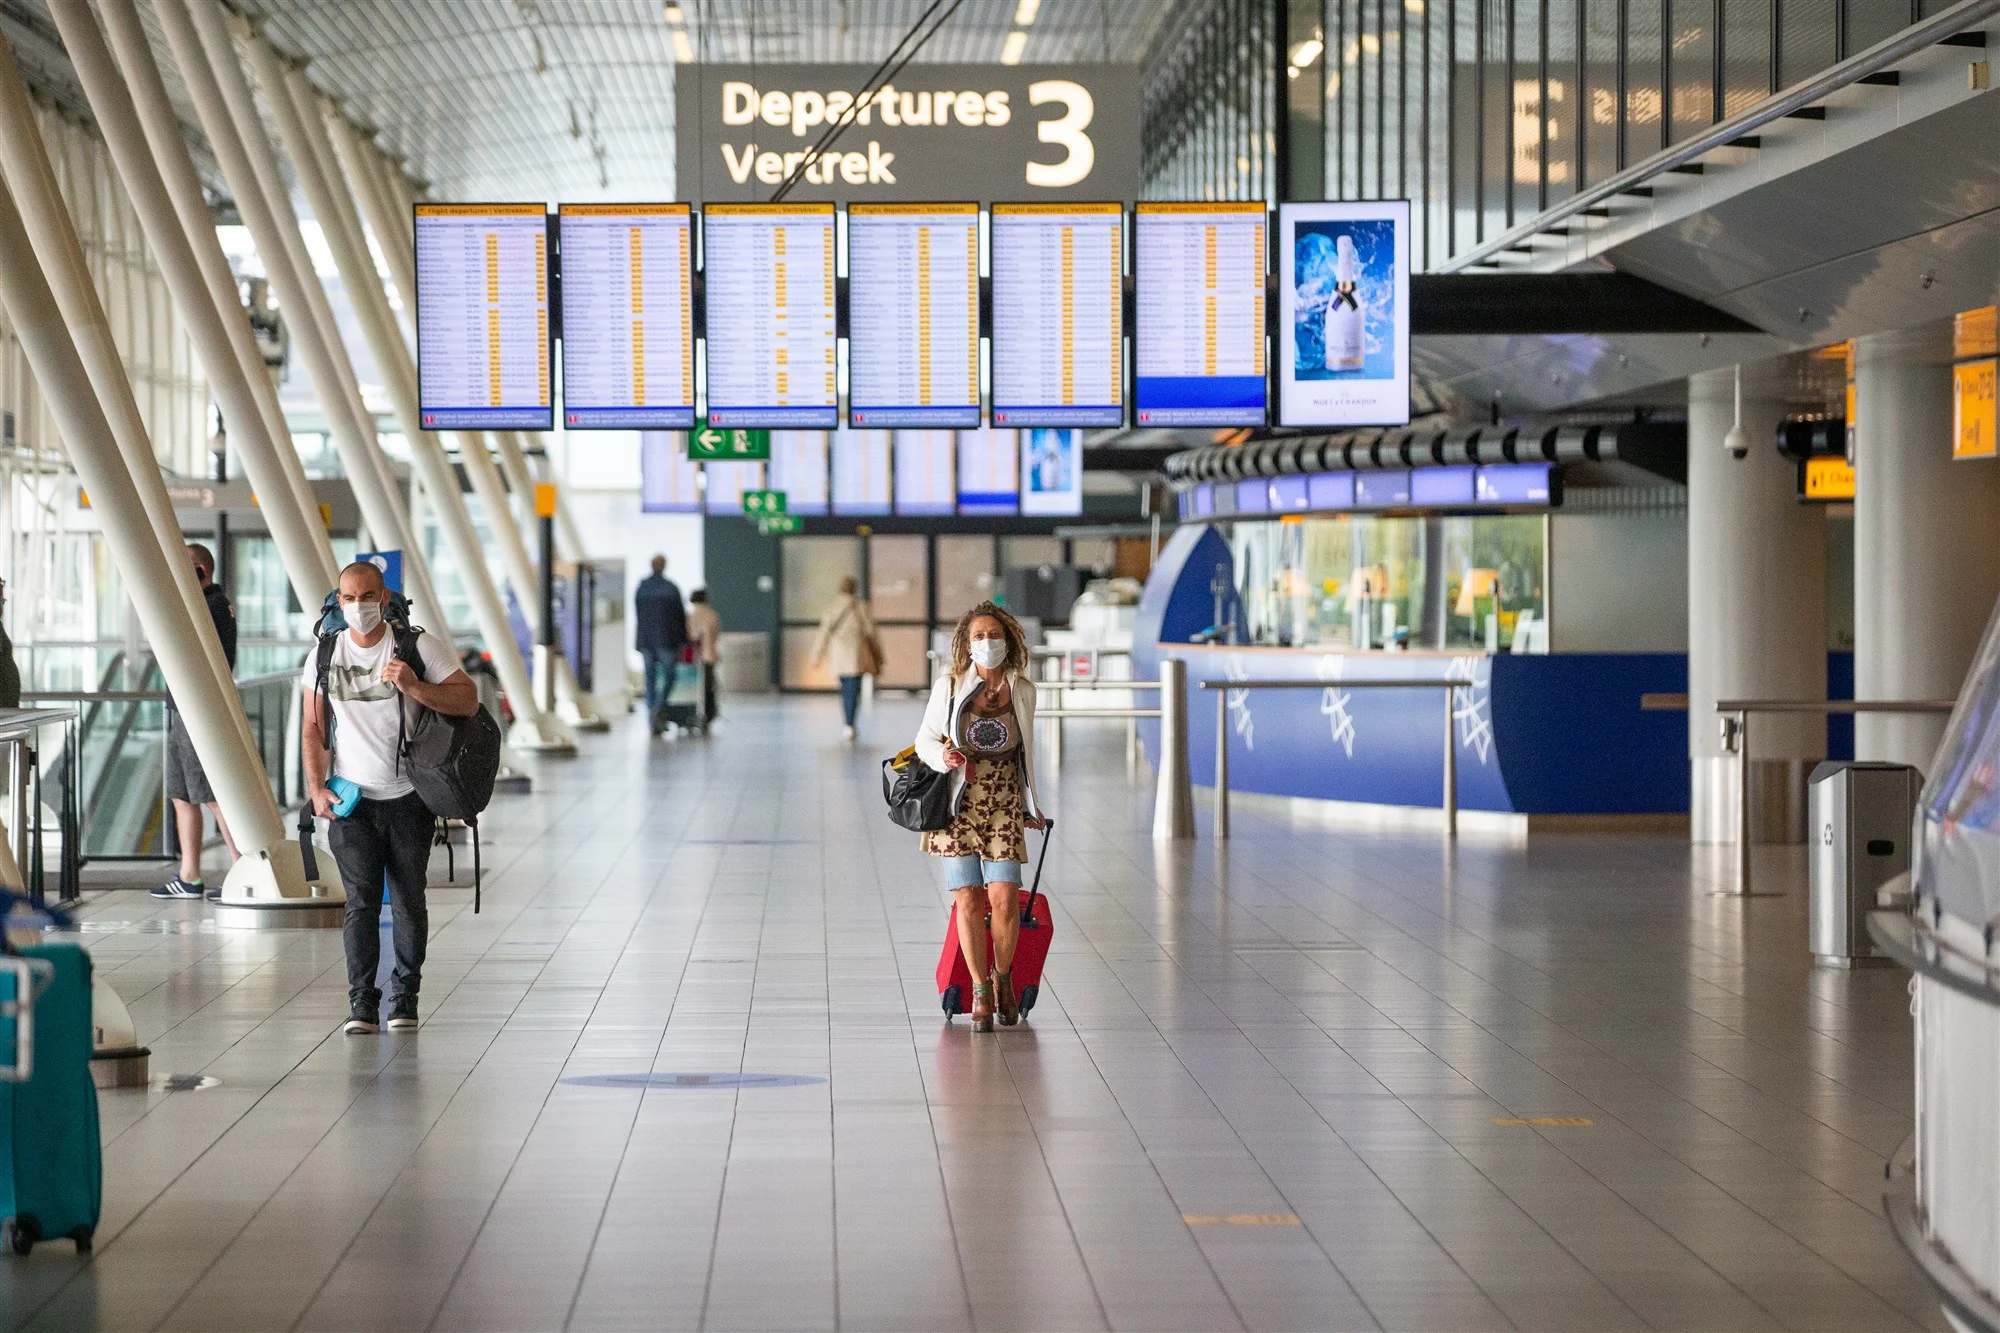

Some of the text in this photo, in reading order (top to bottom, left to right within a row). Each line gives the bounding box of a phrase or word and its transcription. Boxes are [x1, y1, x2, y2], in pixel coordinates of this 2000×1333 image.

[721, 141, 897, 185] Vertrek
[722, 80, 1094, 187] Departures 3
